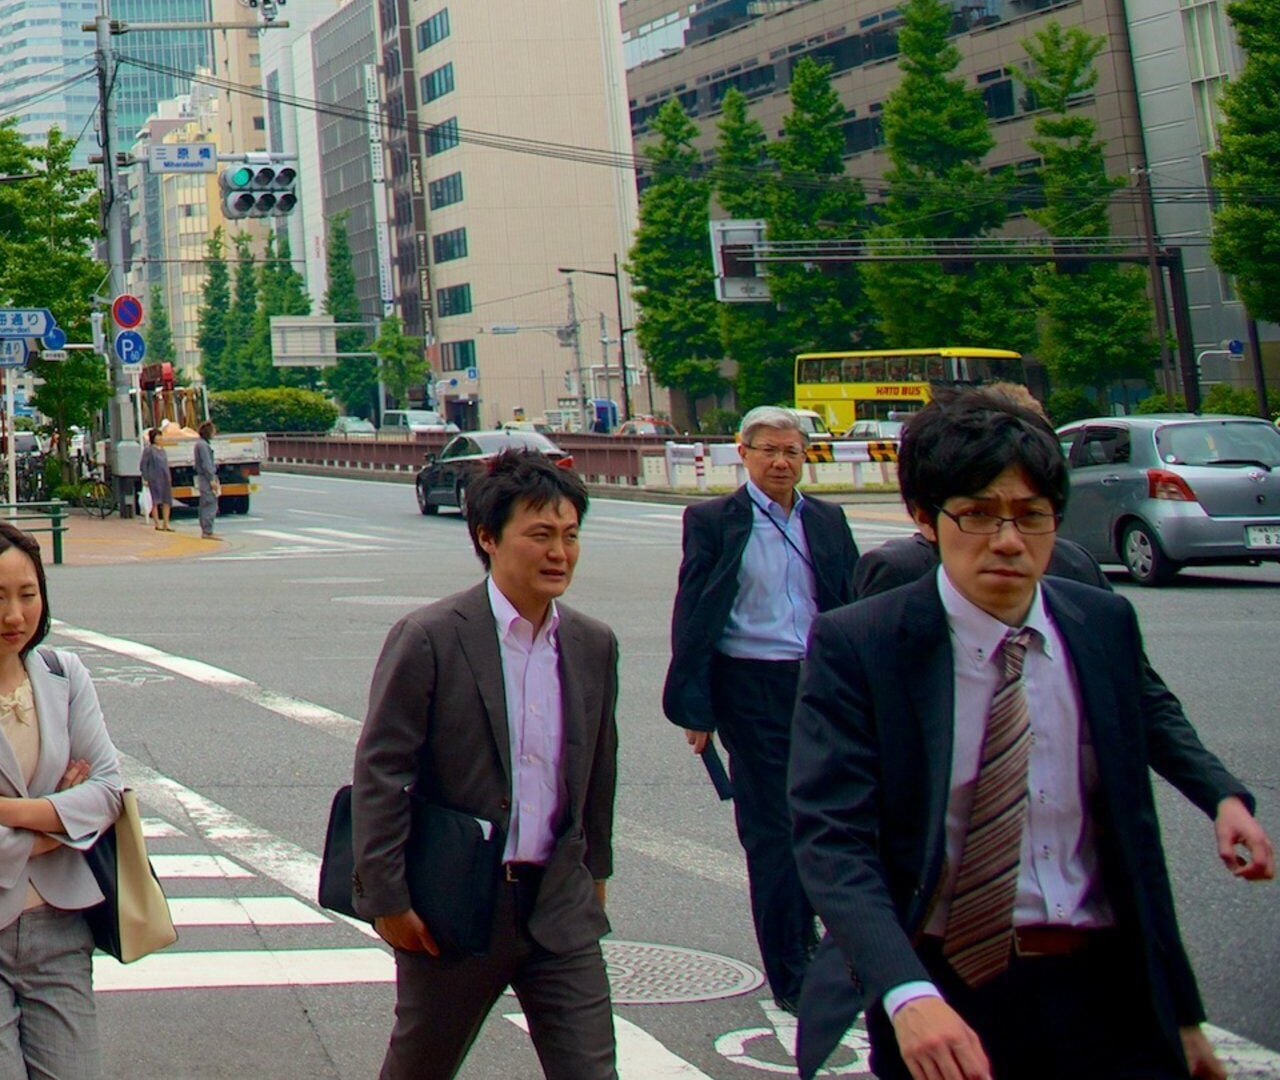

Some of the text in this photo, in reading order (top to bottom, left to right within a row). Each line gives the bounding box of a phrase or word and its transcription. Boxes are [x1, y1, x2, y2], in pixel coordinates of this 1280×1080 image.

[155, 147, 211, 160] 三原橋
[876, 385, 921, 395] HATO BUS
